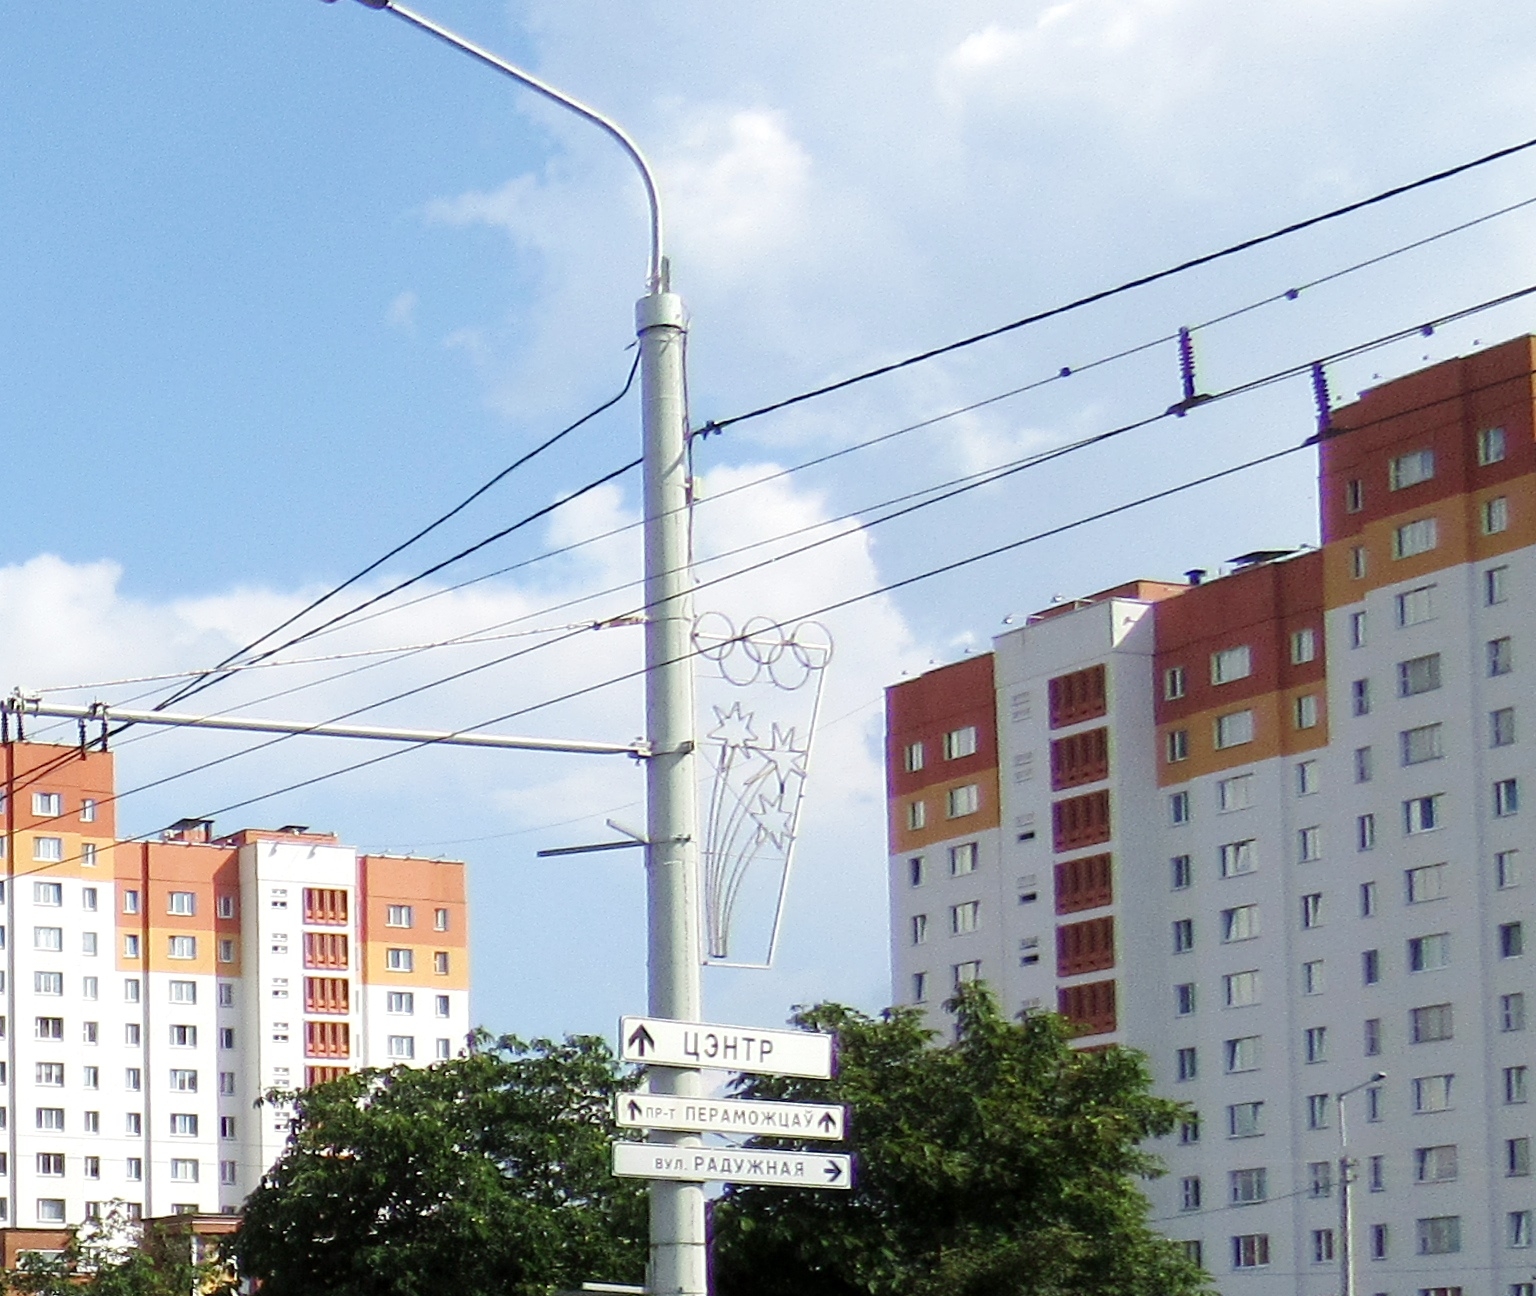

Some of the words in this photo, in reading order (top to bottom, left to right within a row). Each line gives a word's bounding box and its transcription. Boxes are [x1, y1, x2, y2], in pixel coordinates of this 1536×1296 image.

[684, 1031, 774, 1063] ЦЭНТР
[685, 1105, 814, 1128] ПЕРАМОЖЦАЎ
[694, 1155, 805, 1177] РАДУЖНАЯ
